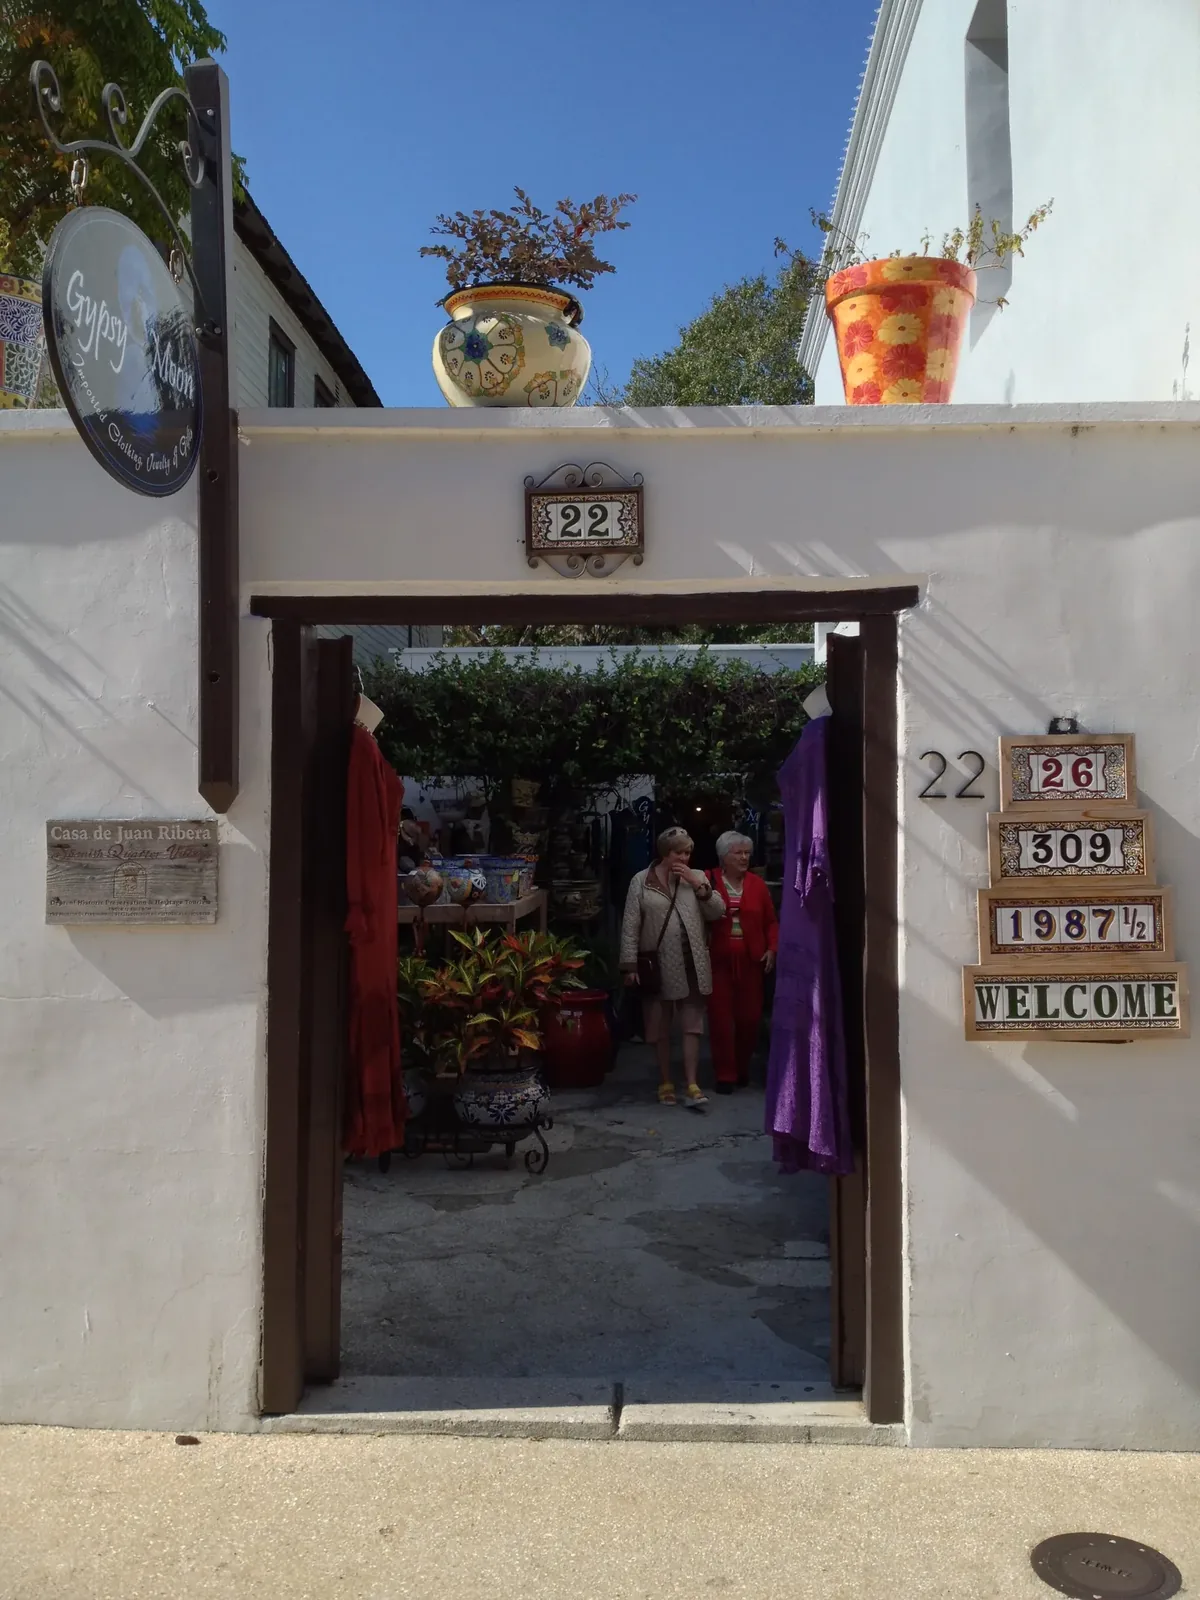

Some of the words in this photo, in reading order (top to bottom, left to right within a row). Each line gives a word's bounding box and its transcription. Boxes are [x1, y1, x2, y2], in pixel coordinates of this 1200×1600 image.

[67, 269, 128, 374] Gypsy
[150, 330, 195, 400] Moon
[72, 352, 108, 423] Imported
[560, 504, 609, 538] 22
[918, 750, 986, 798] 22
[1041, 757, 1093, 788] 26
[51, 826, 88, 840] Casa
[94, 825, 112, 840] de
[114, 826, 153, 844] Juan
[158, 825, 212, 840] Ribera
[1031, 833, 1111, 864] 309
[107, 844, 164, 860] Quarter
[975, 983, 1177, 1020] WELCOME
